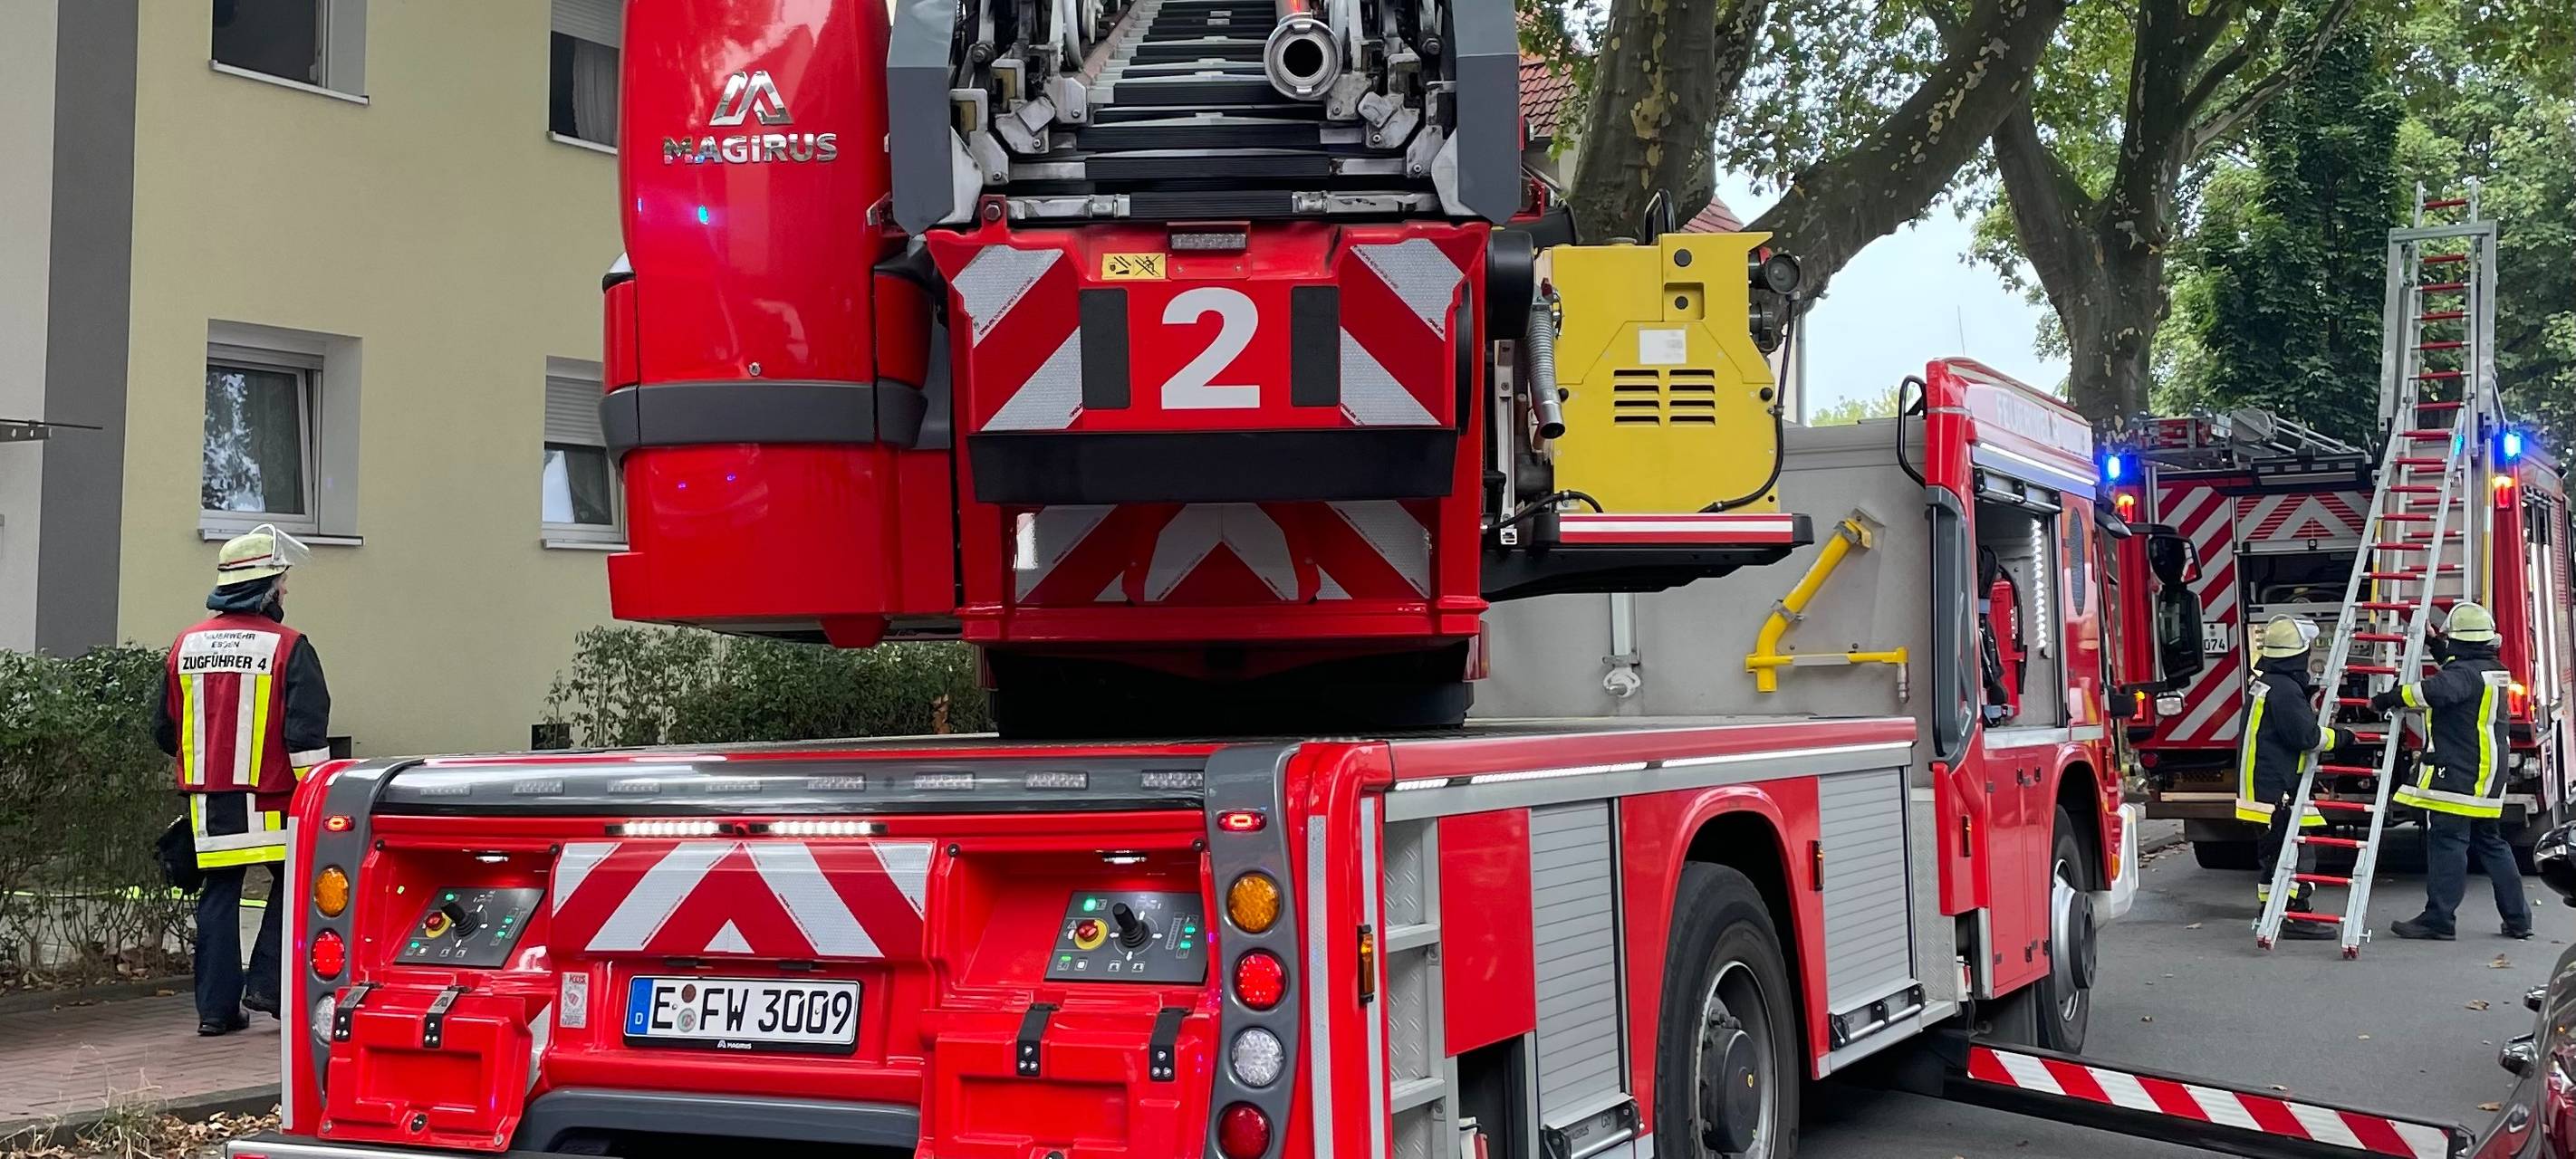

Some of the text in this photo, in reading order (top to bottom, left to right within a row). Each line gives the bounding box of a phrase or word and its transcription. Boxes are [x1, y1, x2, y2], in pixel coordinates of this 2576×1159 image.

[662, 133, 838, 164] MAGIRUS
[1161, 286, 1260, 410] 2
[182, 652, 267, 671] ZUGFÜHRER 4
[634, 1011, 643, 1025] D
[651, 986, 852, 1034] E FW 3009
